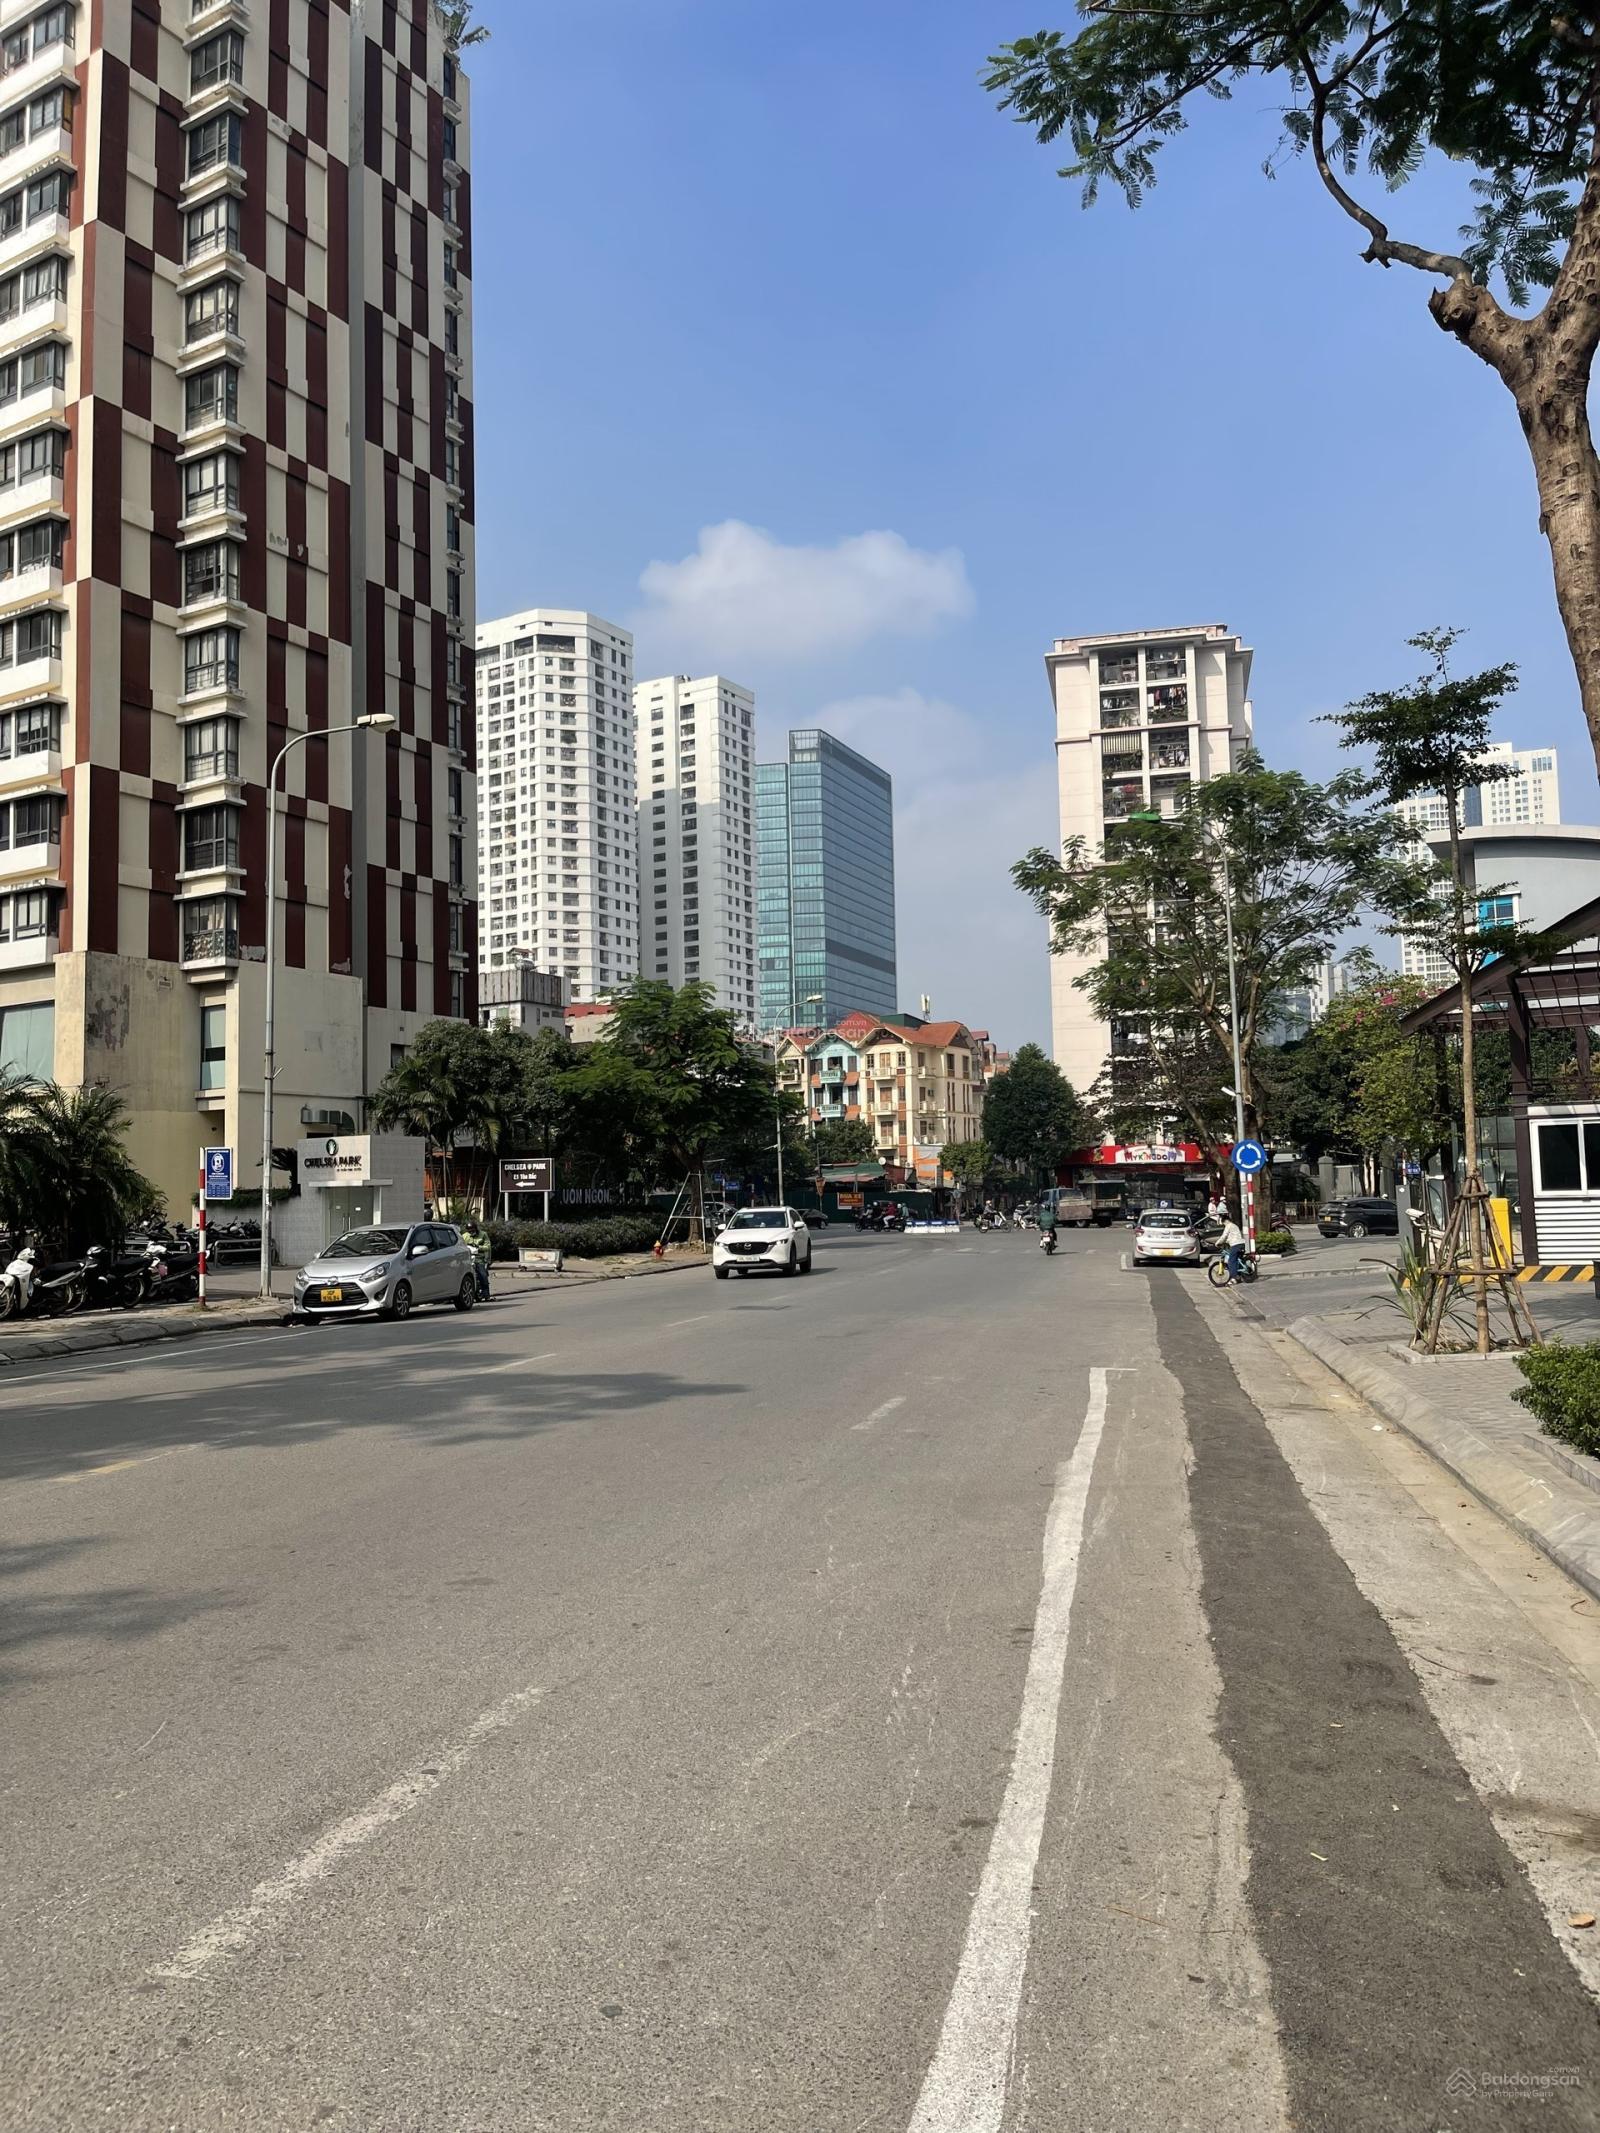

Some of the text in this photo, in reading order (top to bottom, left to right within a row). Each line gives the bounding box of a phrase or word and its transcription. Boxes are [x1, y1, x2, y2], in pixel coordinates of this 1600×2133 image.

[304, 1155, 362, 1168] CHELSEA PARK
[504, 1162, 546, 1171] CHELSEA PARK
